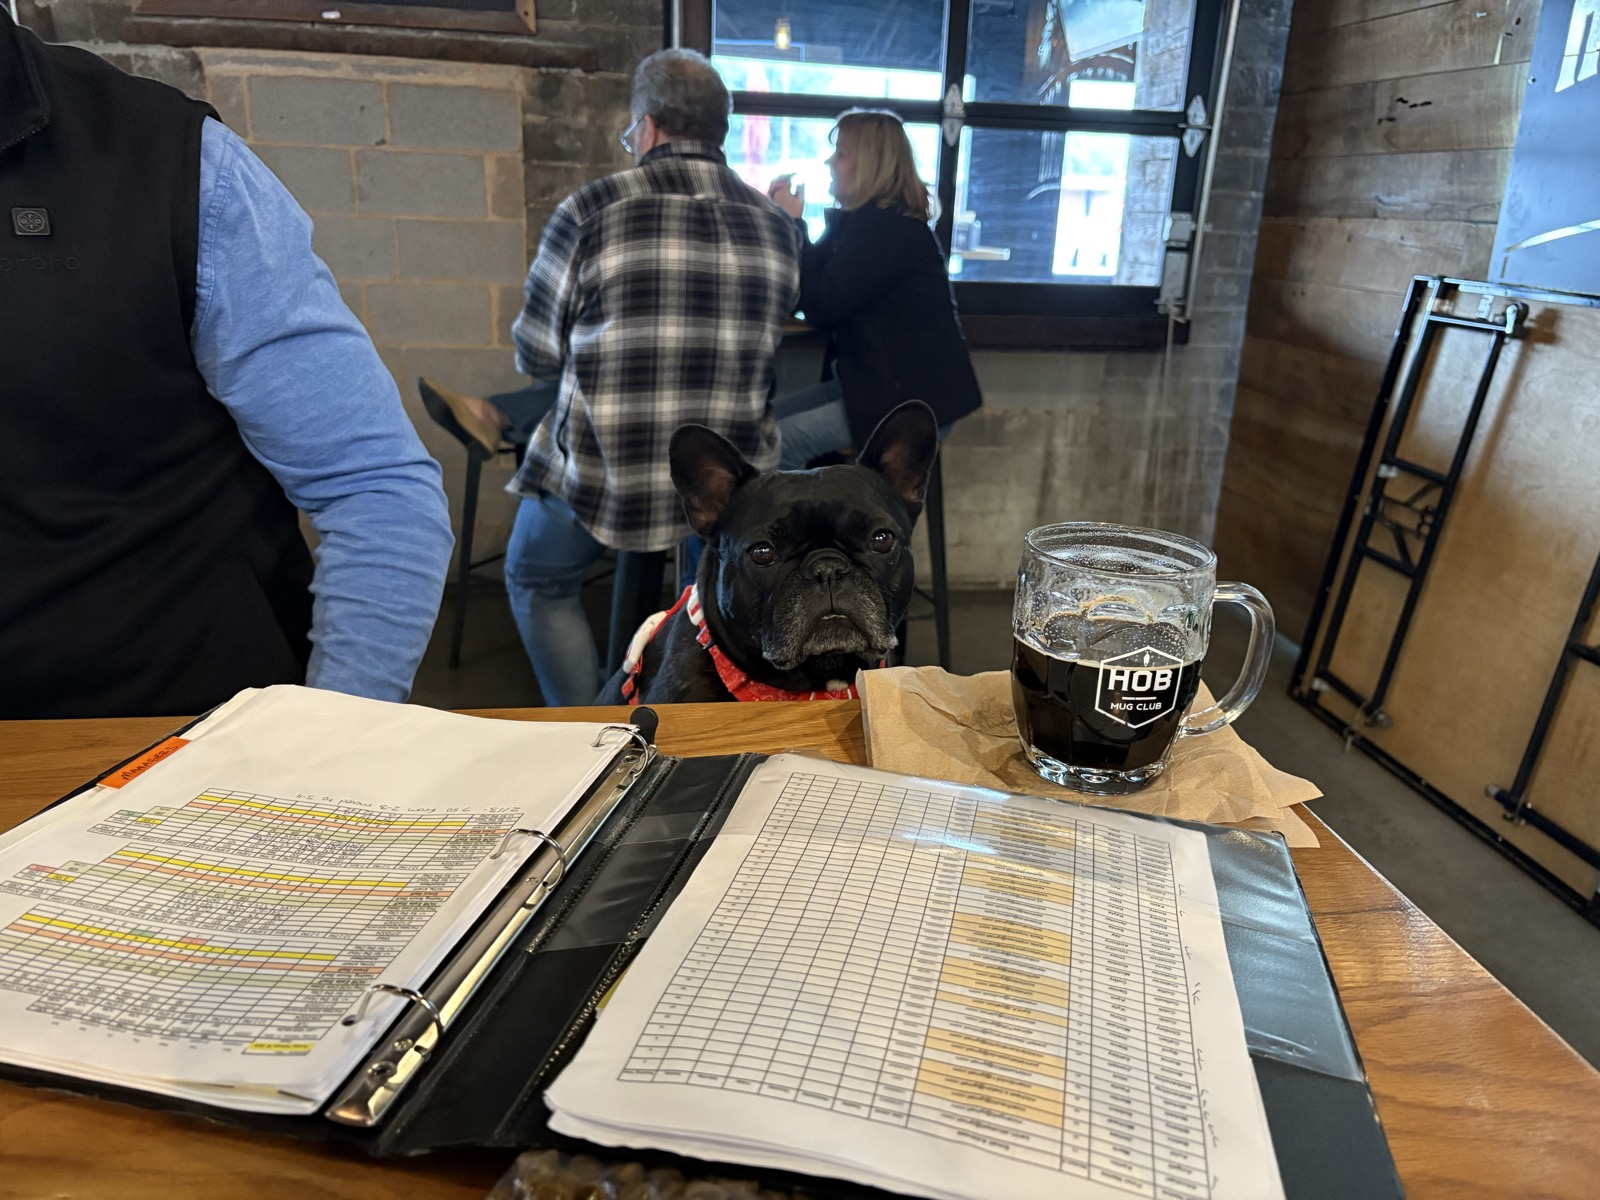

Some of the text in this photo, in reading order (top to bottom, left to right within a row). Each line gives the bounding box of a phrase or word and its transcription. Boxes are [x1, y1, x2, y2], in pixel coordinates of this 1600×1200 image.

[1107, 669, 1173, 692] HOB
[1110, 701, 1162, 711] MUG CLUB
[121, 745, 180, 781] MANAGERS
